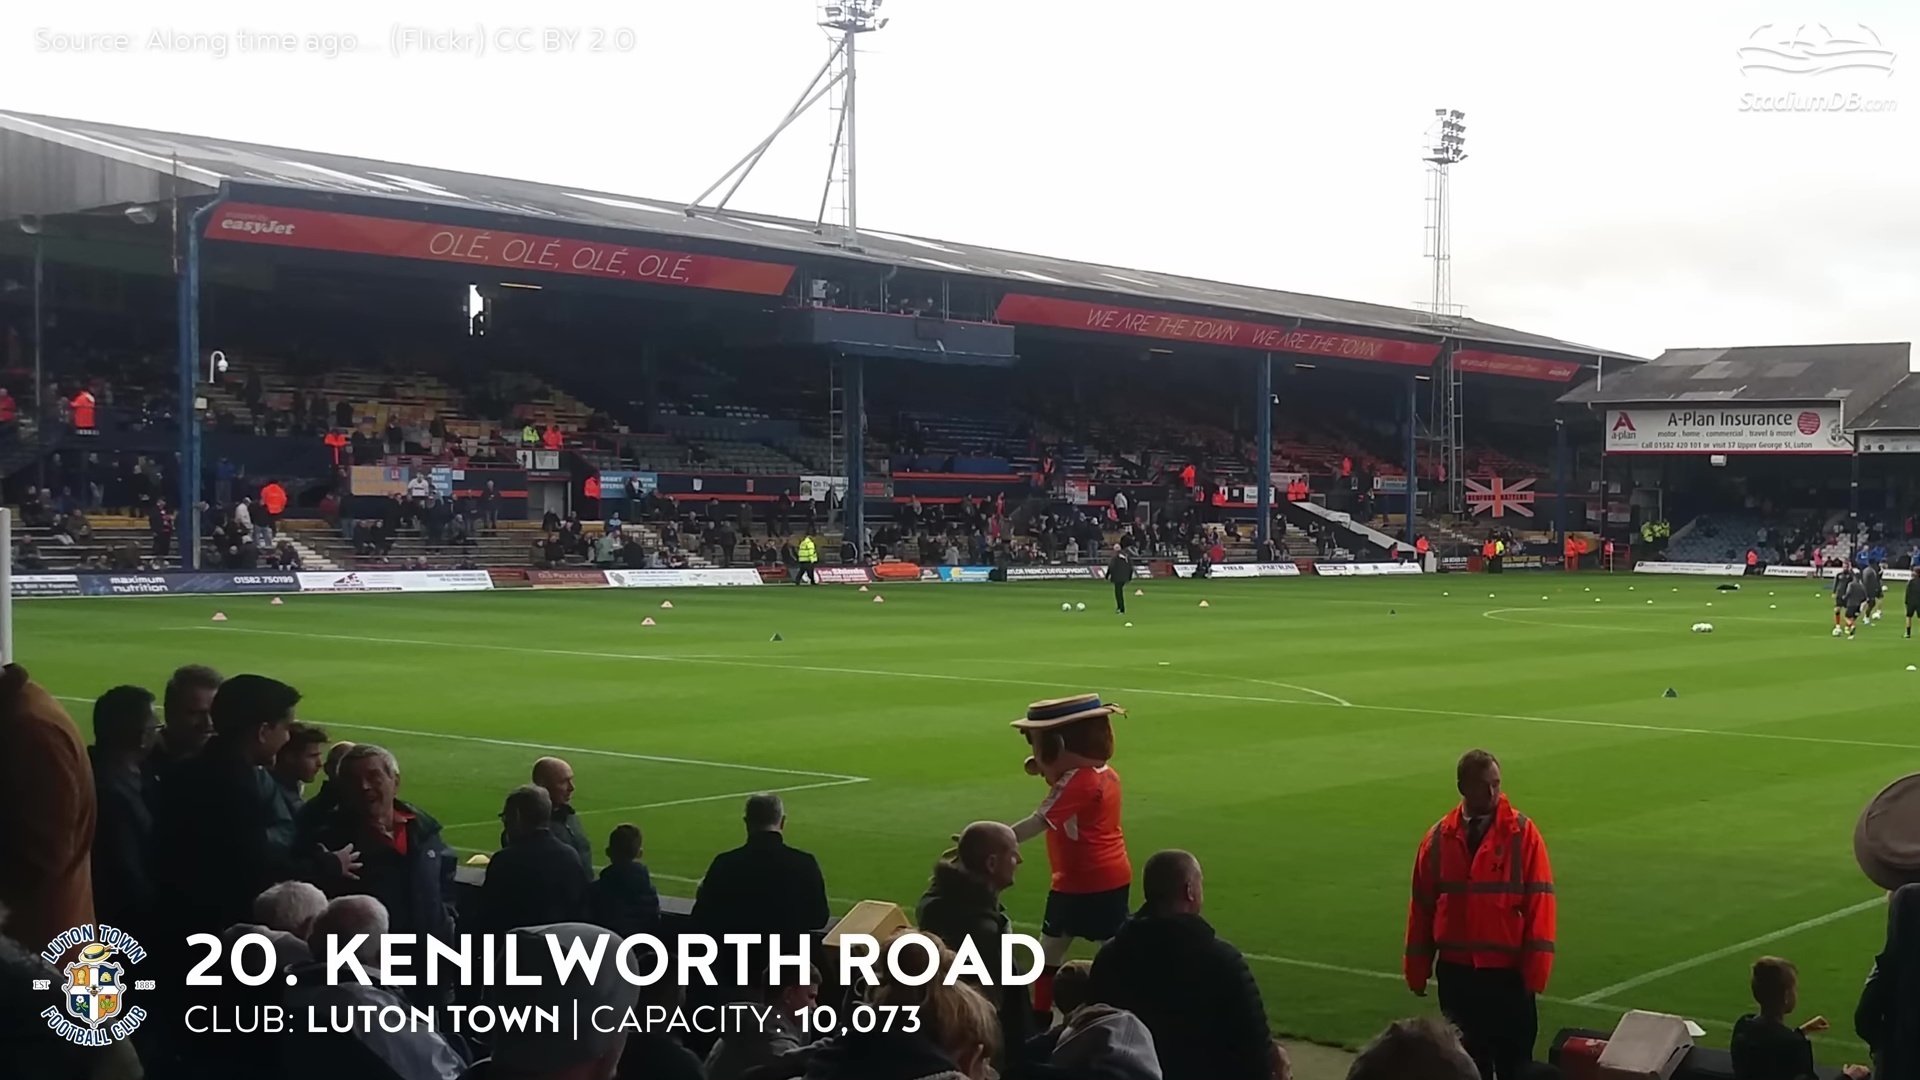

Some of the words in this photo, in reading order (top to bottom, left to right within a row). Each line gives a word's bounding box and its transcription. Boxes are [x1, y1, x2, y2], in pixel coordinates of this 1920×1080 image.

[222, 219, 296, 235] easyJet
[1087, 308, 1119, 328] WE
[1115, 312, 1155, 332] ARE
[1151, 316, 1197, 337] THE
[1191, 320, 1240, 341] TOWN
[1252, 328, 1278, 347] WE
[1277, 332, 1311, 349] ARE
[1309, 335, 1343, 352] THE
[1667, 411, 1715, 427] A-Plan
[1720, 411, 1793, 427] Insurance
[1657, 430, 1677, 438] motor
[1682, 430, 1700, 438] home
[1706, 430, 1744, 438] commercial
[1749, 430, 1768, 438] travel
[1641, 441, 1653, 449] Call
[1654, 441, 1674, 449] 01582
[1676, 441, 1688, 449] 420
[1690, 441, 1701, 449] 101
[1712, 441, 1726, 449] visit
[1727, 441, 1736, 449] 37
[1737, 441, 1757, 450] Upper
[1758, 441, 1782, 450] George
[1794, 441, 1813, 449] Luton
[110, 575, 166, 584] maximum
[233, 576, 262, 585] 01582
[113, 583, 169, 593] nutrition
